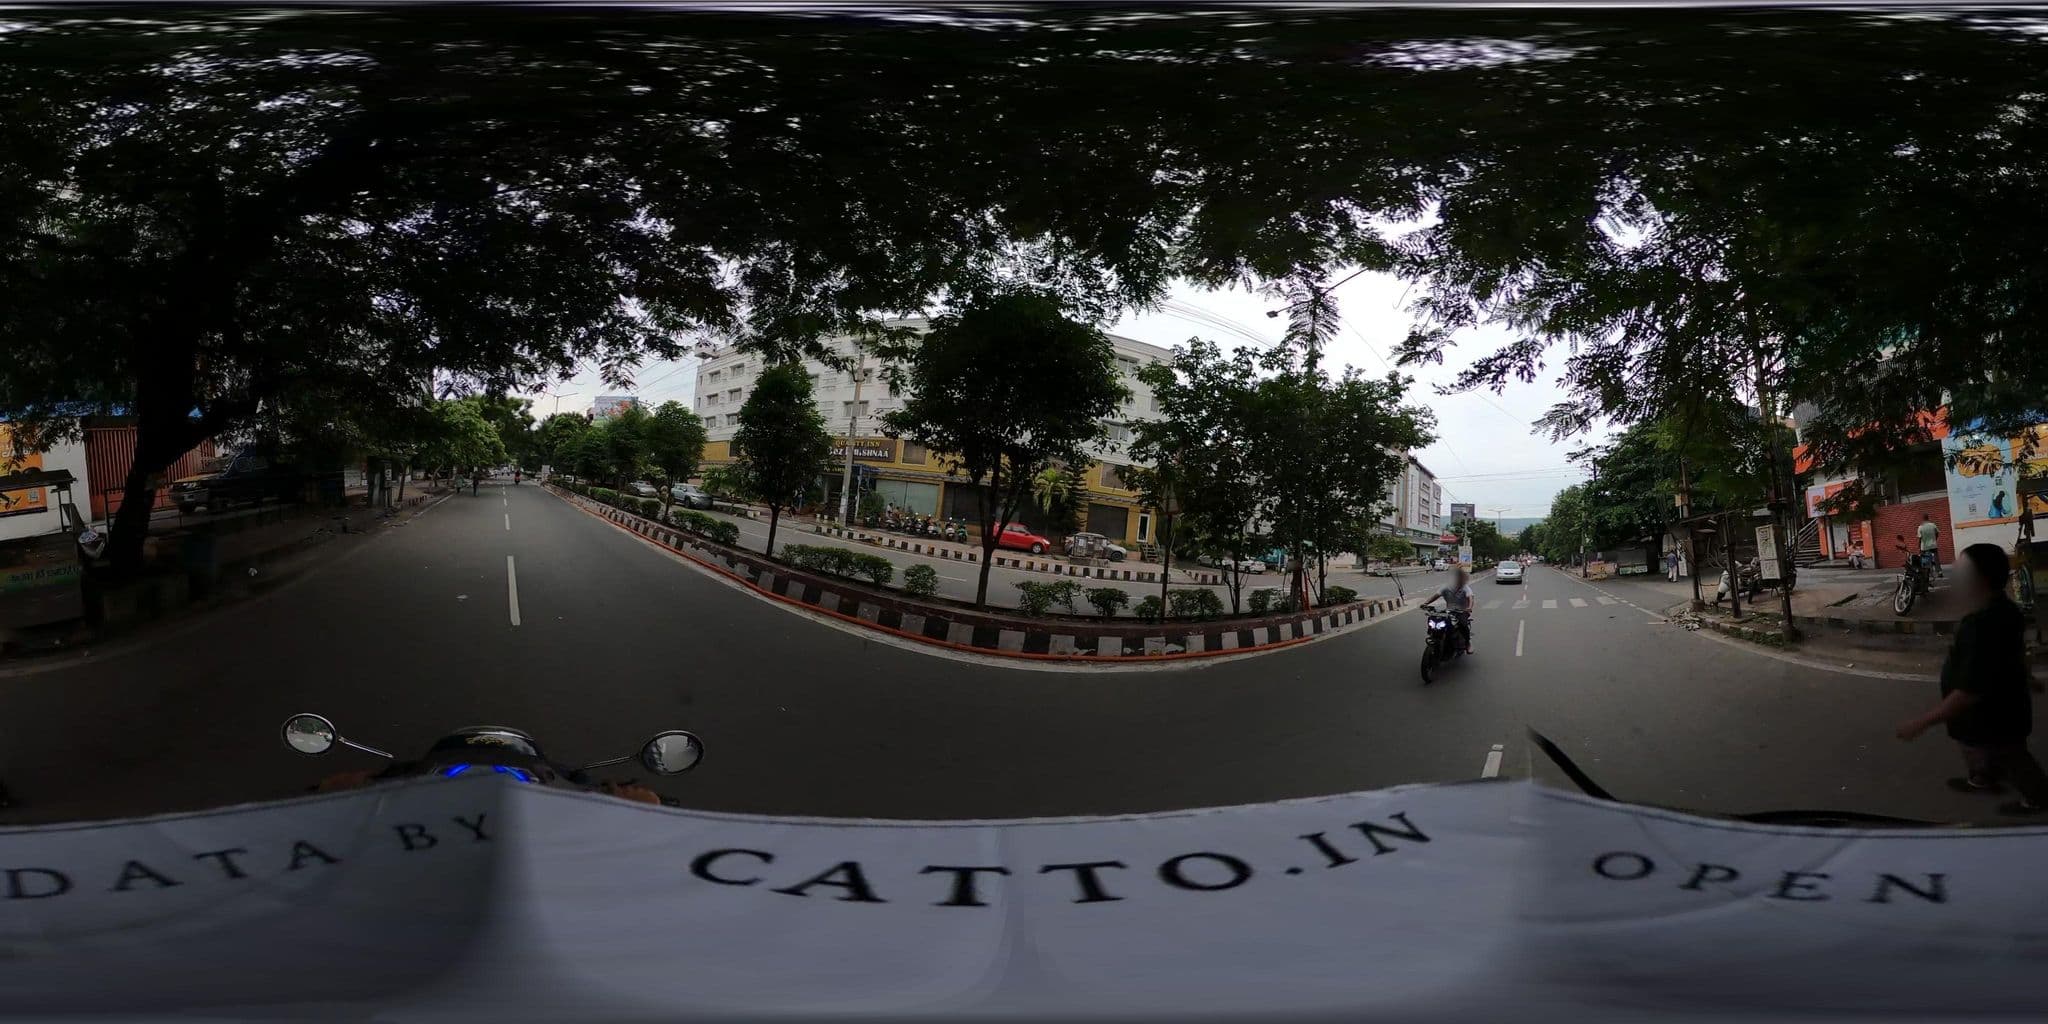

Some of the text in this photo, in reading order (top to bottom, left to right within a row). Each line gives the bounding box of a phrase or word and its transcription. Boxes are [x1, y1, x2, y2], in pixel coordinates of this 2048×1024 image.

[4, 813, 493, 901] DATA BY
[690, 811, 1432, 907] CATTO.IN
[1592, 851, 1948, 904] OPEN
